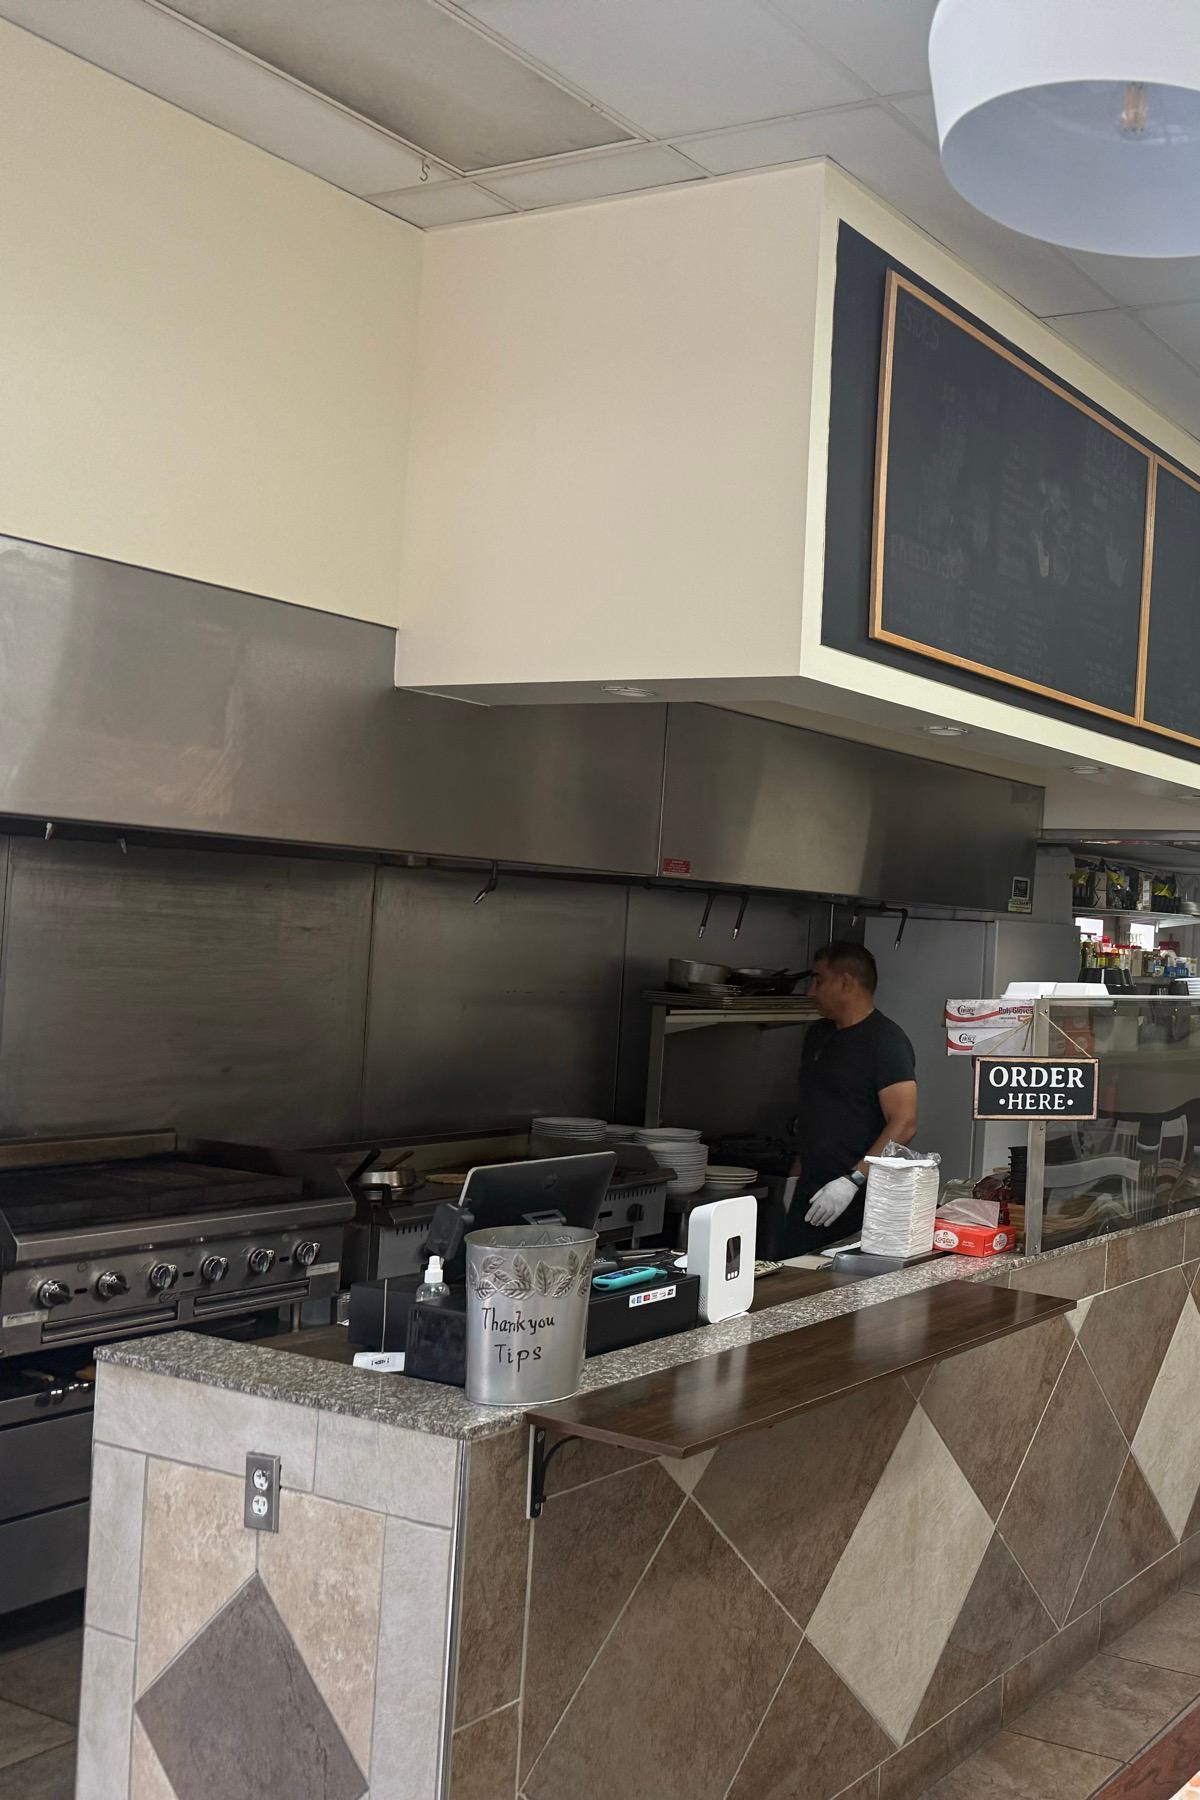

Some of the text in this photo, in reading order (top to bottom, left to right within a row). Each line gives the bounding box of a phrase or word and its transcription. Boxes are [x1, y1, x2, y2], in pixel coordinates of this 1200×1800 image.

[989, 1066, 1085, 1088] ORDER
[1007, 1093, 1066, 1110] HERE
[481, 1307, 555, 1335] Thank you
[494, 1343, 542, 1373] Tips
